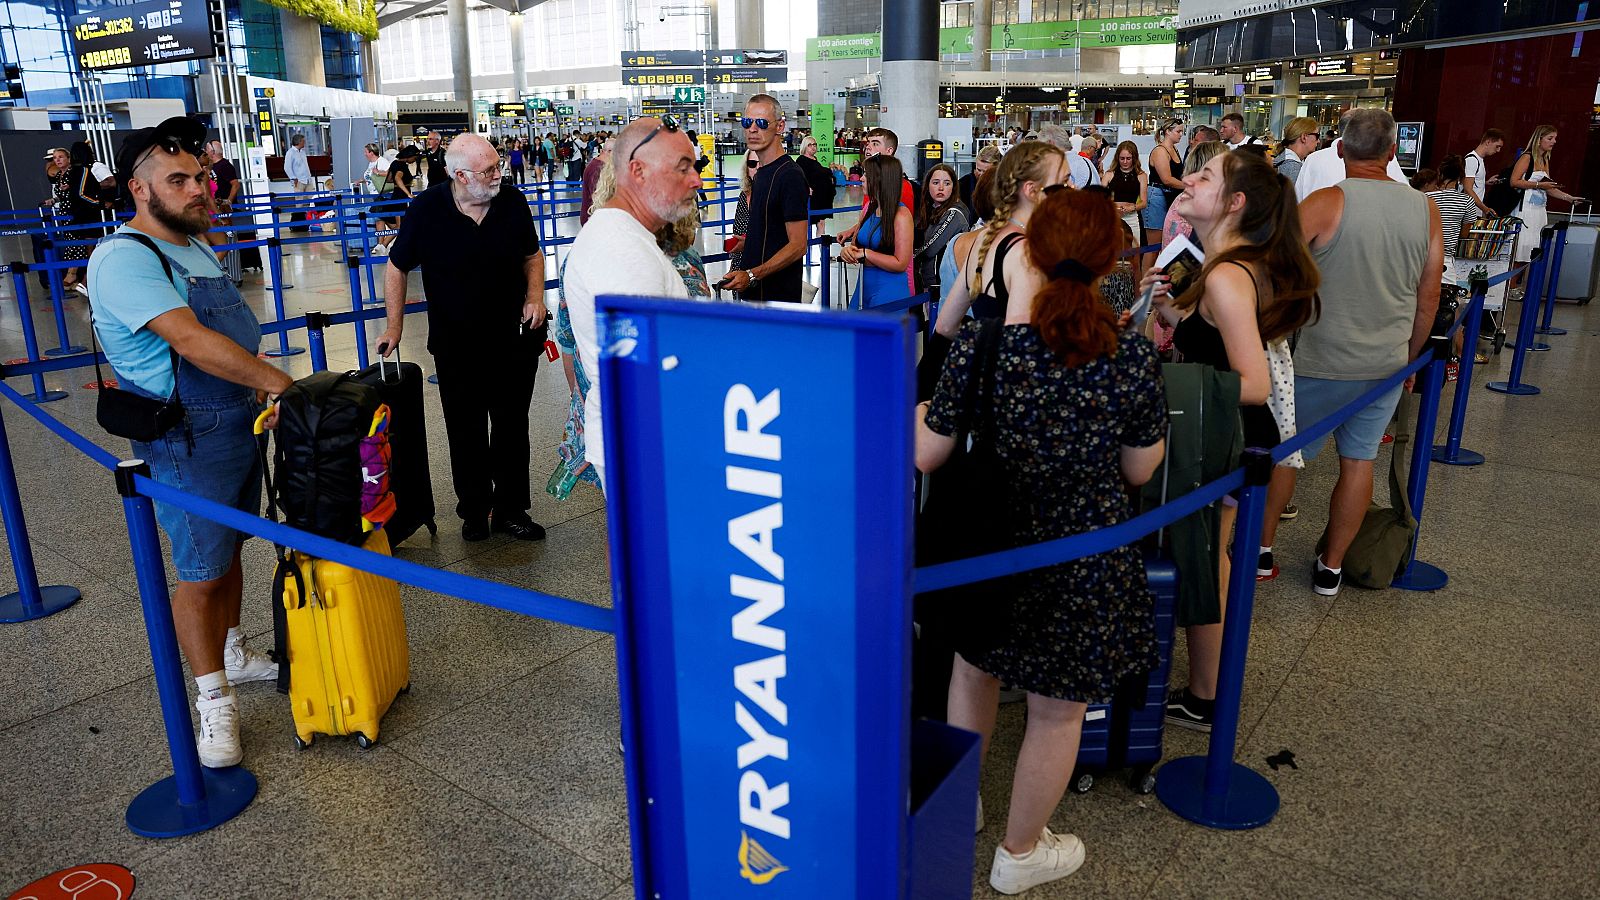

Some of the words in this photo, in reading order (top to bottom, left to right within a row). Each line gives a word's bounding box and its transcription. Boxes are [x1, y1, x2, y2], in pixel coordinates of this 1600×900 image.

[1100, 23, 1118, 32] 100
[1119, 21, 1141, 31] años
[1143, 20, 1178, 31] congo
[1119, 32, 1142, 42] Years
[817, 39, 830, 48] 100
[831, 38, 848, 46] años
[848, 38, 874, 47] contigo
[831, 49, 849, 57] Years
[850, 48, 874, 57] Serving
[724, 383, 790, 840] RYANAIR
